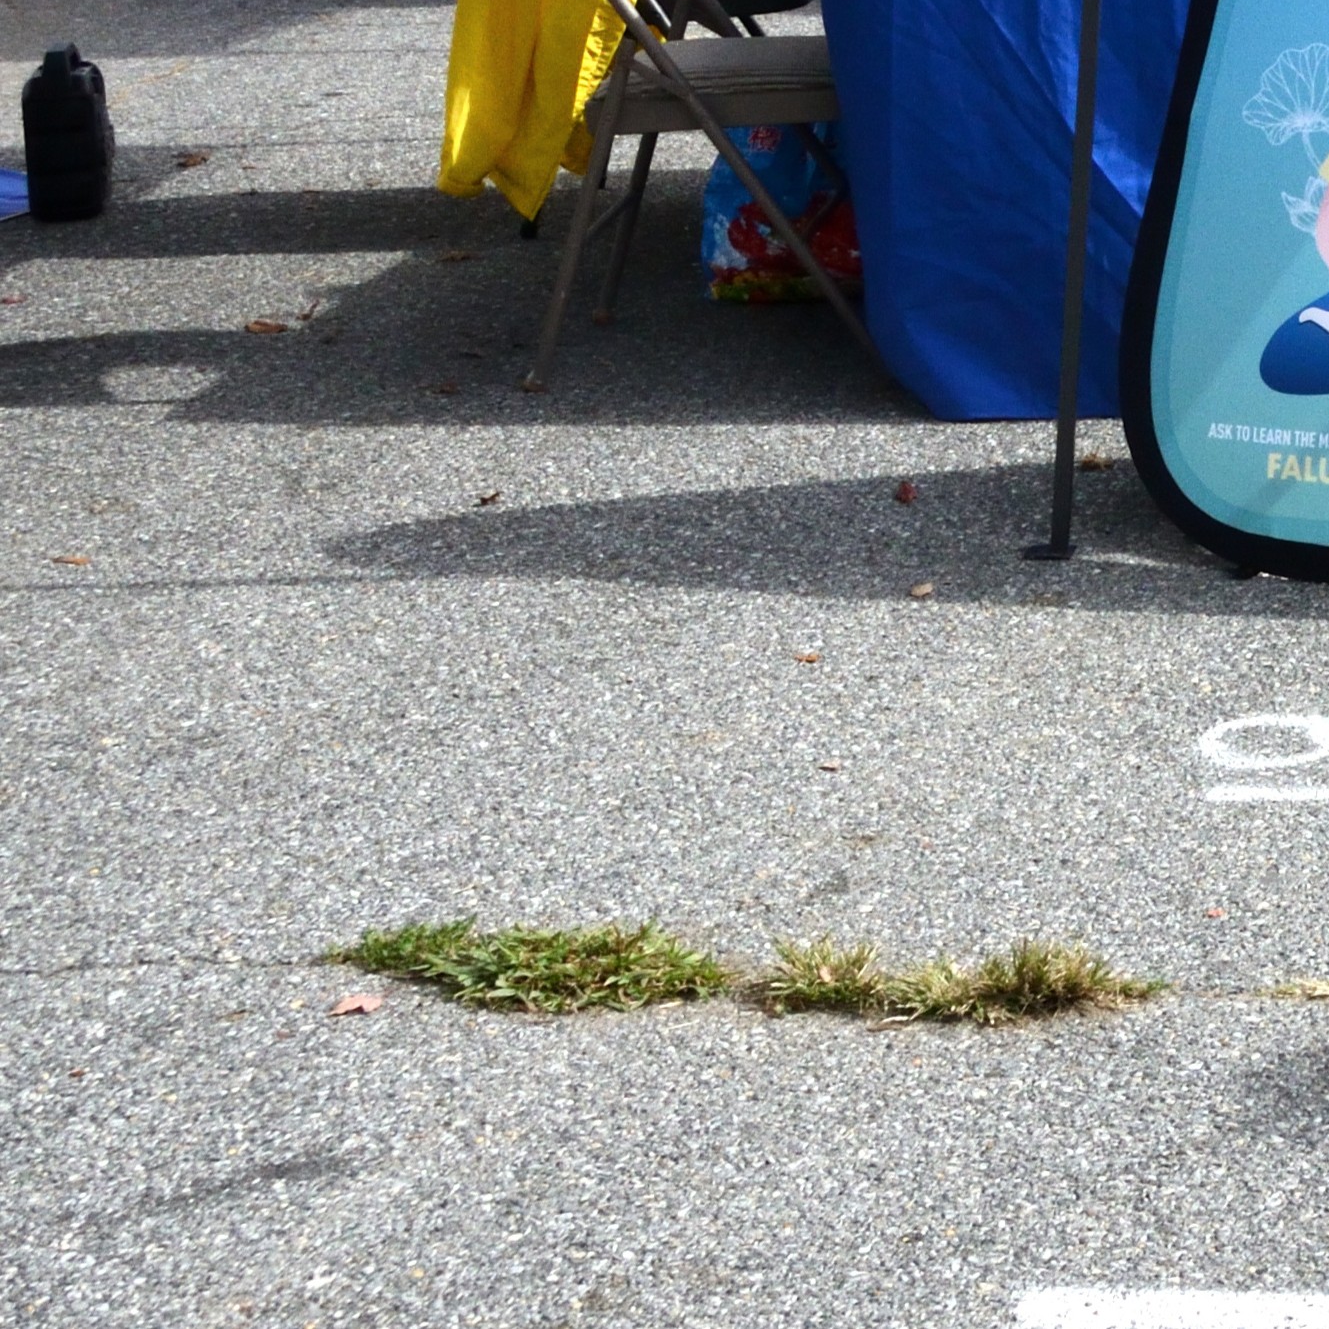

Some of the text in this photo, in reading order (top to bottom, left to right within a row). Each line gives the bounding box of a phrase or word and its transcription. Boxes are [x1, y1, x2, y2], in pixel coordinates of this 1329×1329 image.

[1207, 422, 1234, 440] ASK
[1236, 424, 1251, 442] TO
[1252, 426, 1291, 446] LEARN
[1294, 430, 1316, 448] THE
